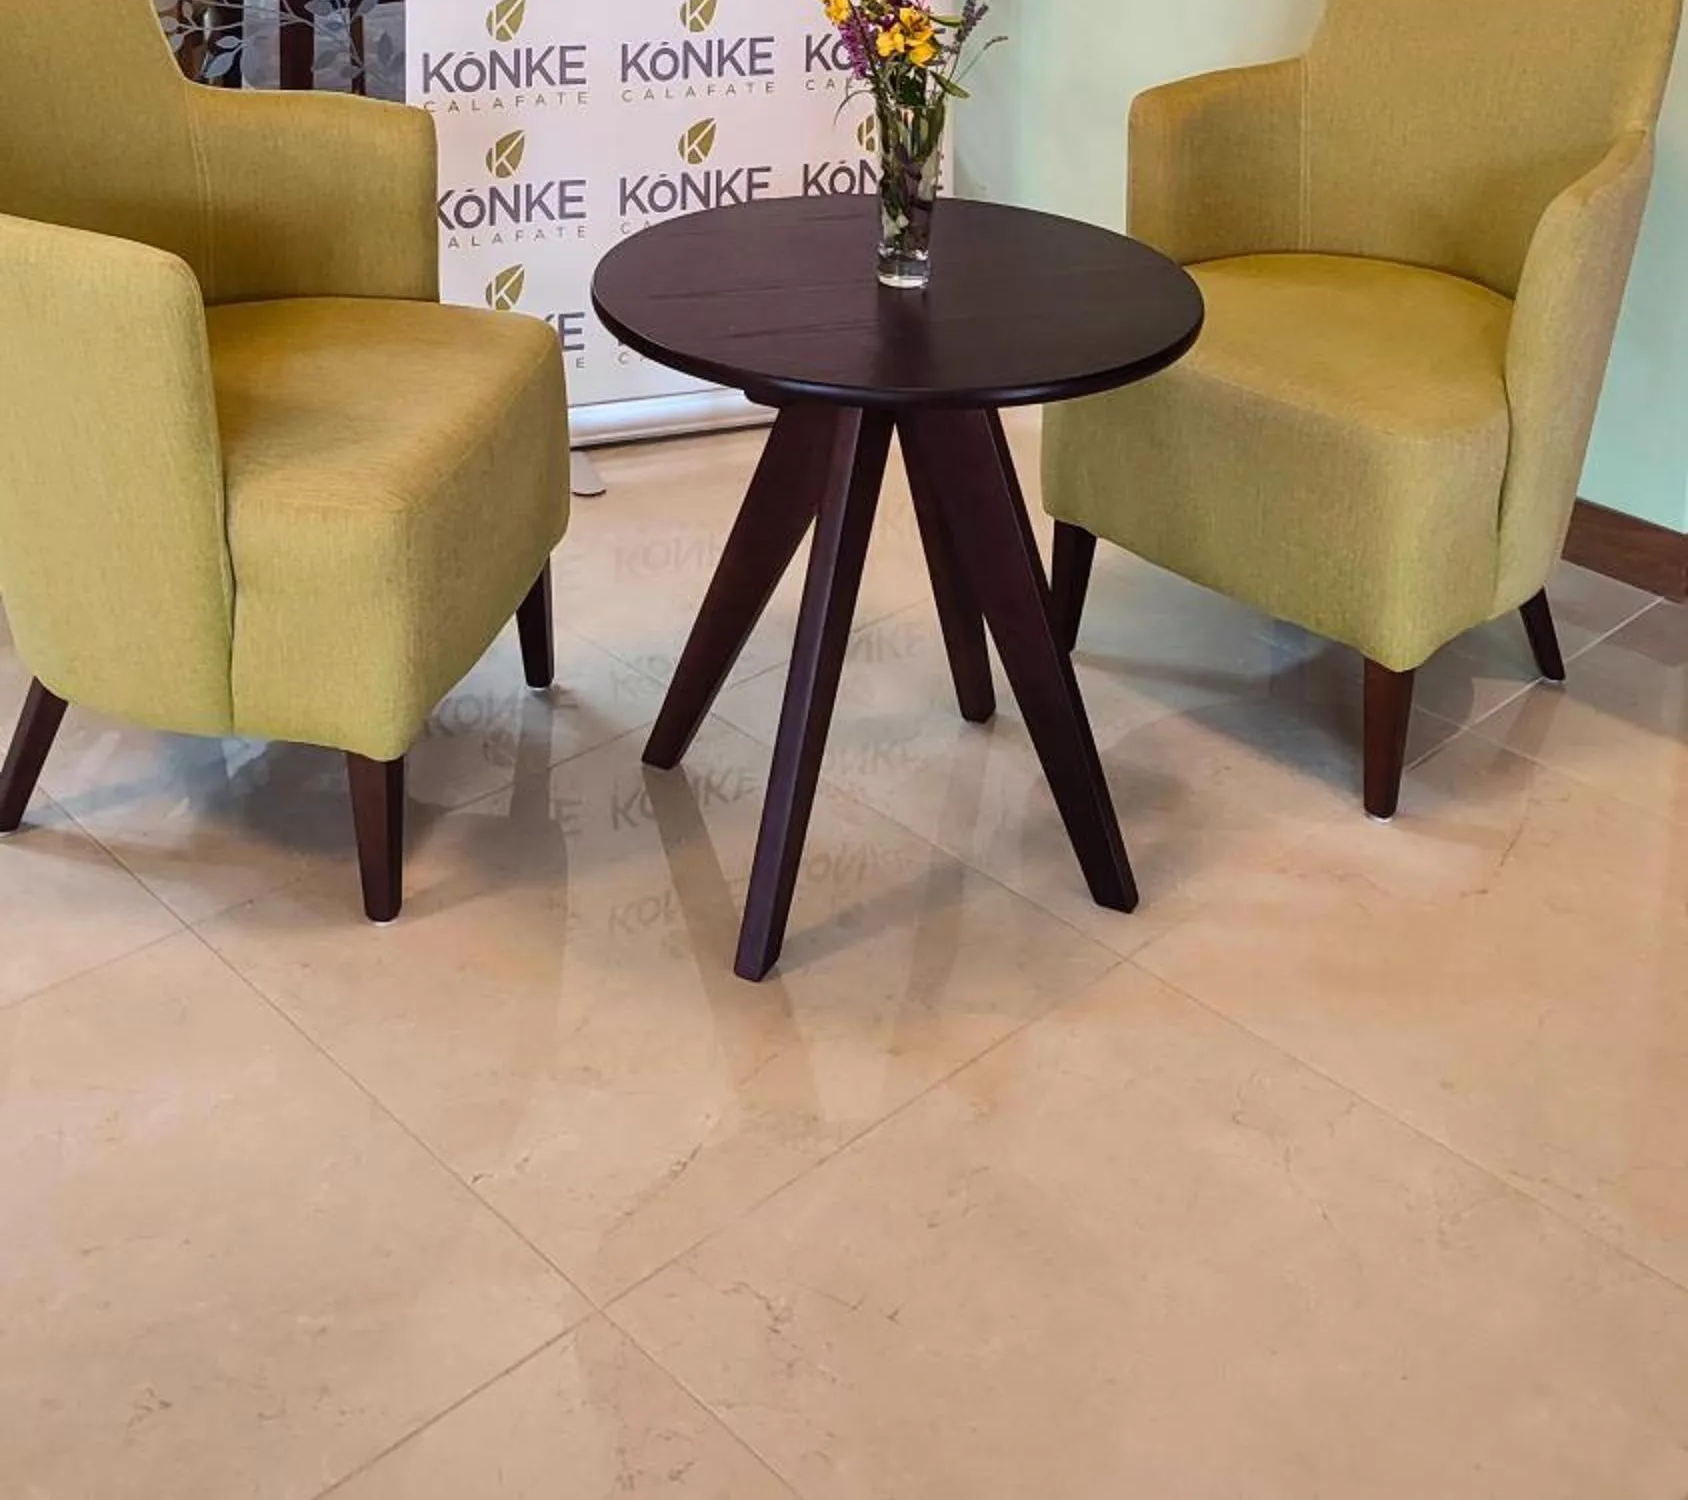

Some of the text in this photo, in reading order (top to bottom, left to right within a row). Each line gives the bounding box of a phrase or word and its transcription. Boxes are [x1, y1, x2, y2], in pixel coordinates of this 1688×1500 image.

[424, 92, 588, 112] CALAFATE
[621, 82, 775, 102] CALAFATE
[448, 226, 587, 248] ALAFATE
